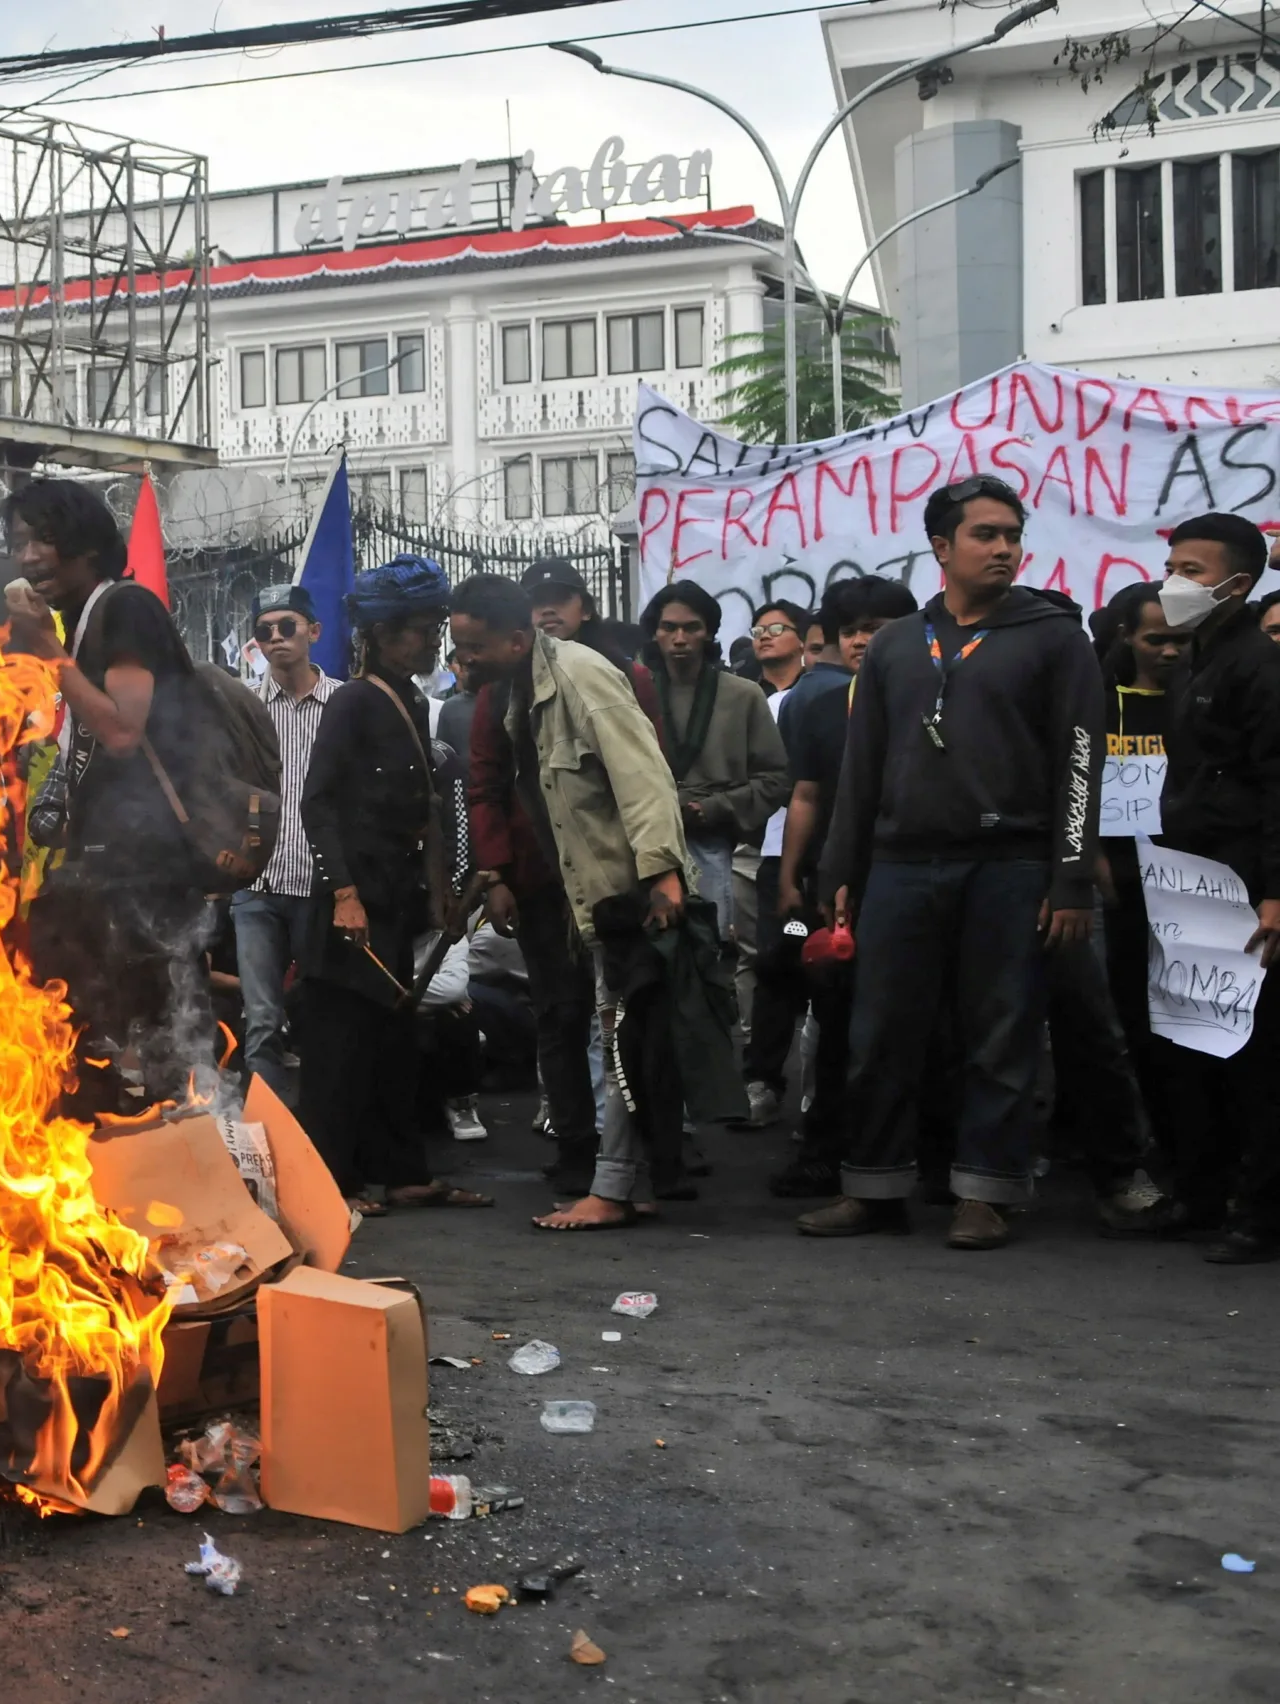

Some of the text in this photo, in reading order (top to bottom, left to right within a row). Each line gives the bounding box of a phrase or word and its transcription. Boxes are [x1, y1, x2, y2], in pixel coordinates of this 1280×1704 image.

[294, 135, 713, 252] dprd jabar
[638, 432, 1132, 569] PERAMPASAN
